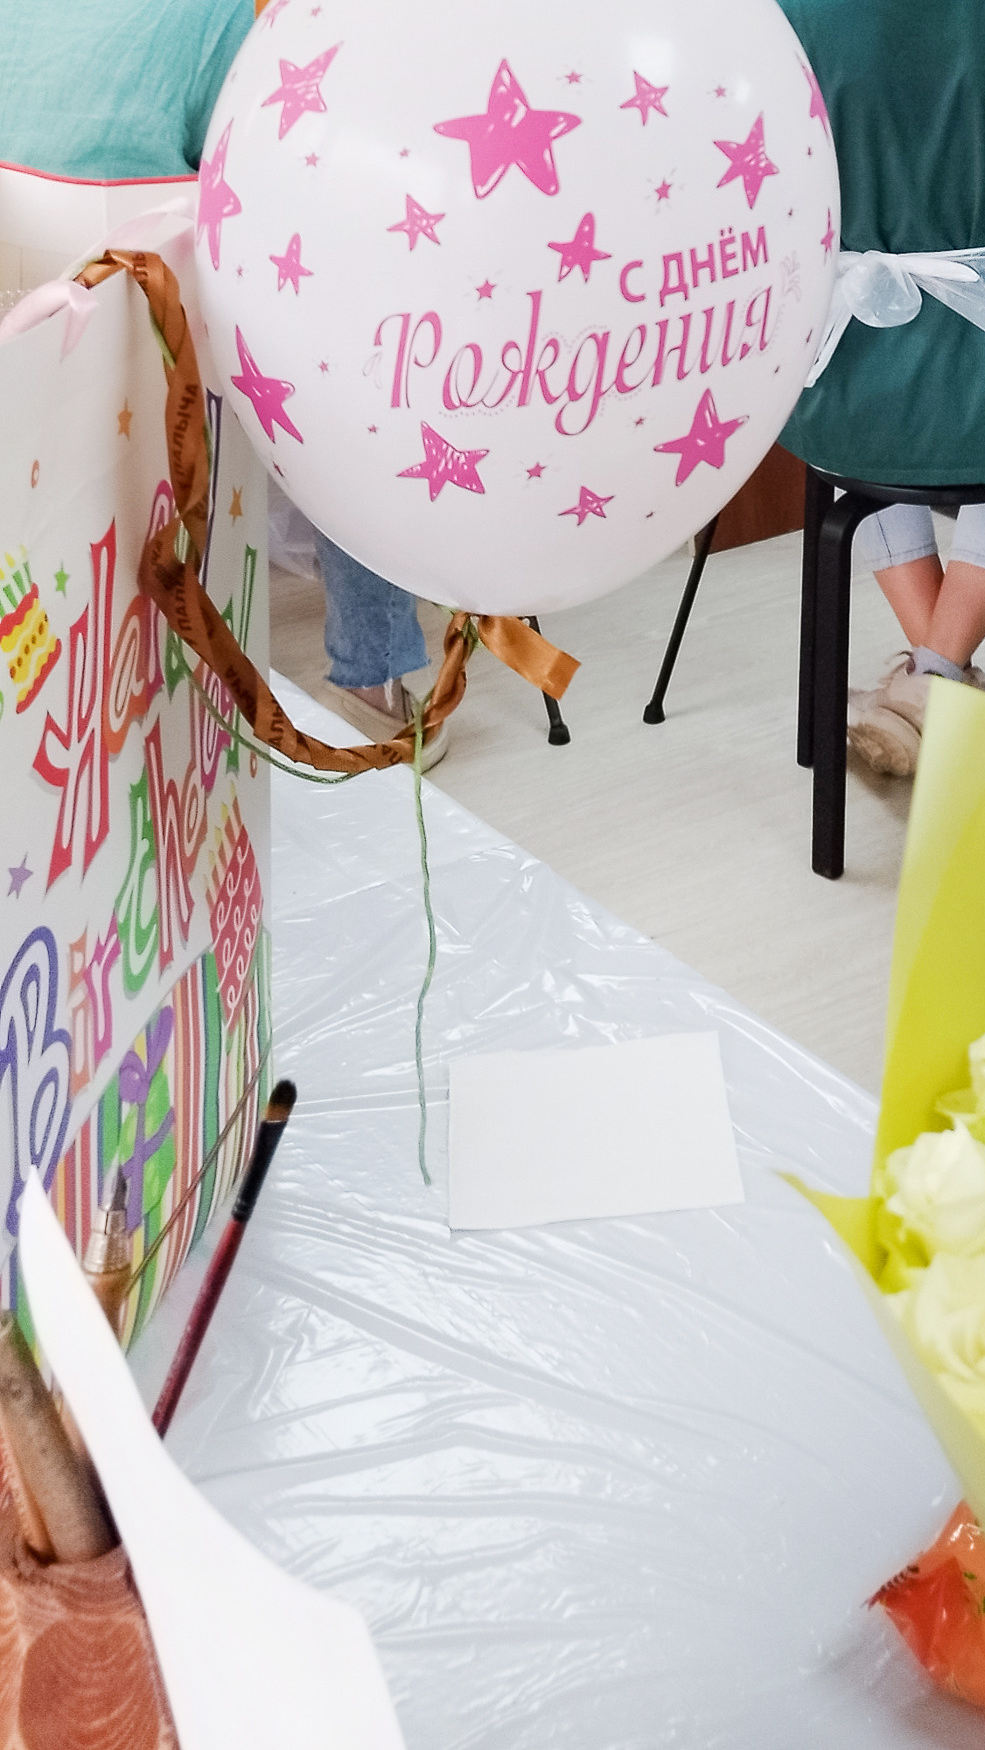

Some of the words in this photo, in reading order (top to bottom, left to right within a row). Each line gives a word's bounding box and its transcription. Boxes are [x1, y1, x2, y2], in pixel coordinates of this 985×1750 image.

[619, 261, 645, 303] С
[660, 226, 769, 307] ДНЁМ
[374, 286, 773, 436] Рождения
[173, 384, 199, 476] ПАЛЫЧА
